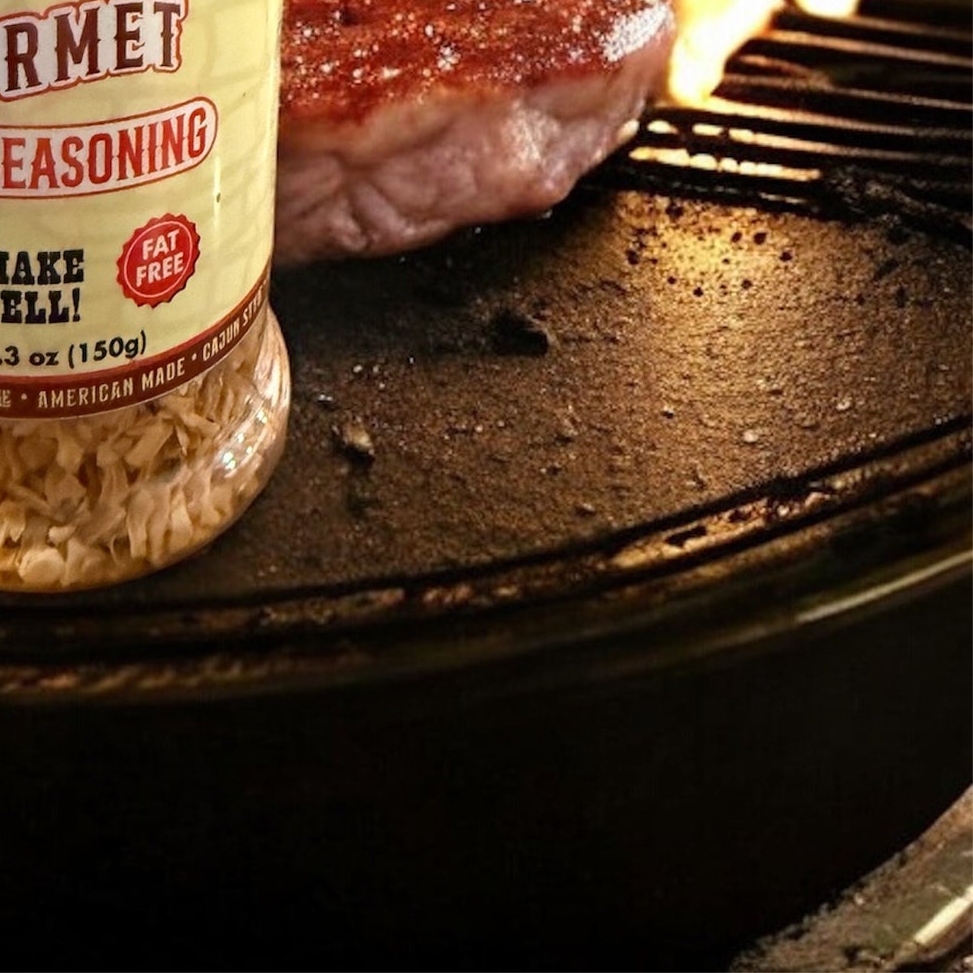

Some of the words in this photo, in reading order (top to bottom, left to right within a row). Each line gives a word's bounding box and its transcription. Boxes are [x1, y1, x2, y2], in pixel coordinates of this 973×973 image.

[142, 228, 180, 261] FAT
[135, 251, 184, 288] FREE
[29, 350, 59, 367] oz
[68, 329, 147, 369] (150g)
[37, 379, 134, 409] AMERICAN
[141, 357, 186, 392] MADE
[202, 317, 240, 362] CAJUN
